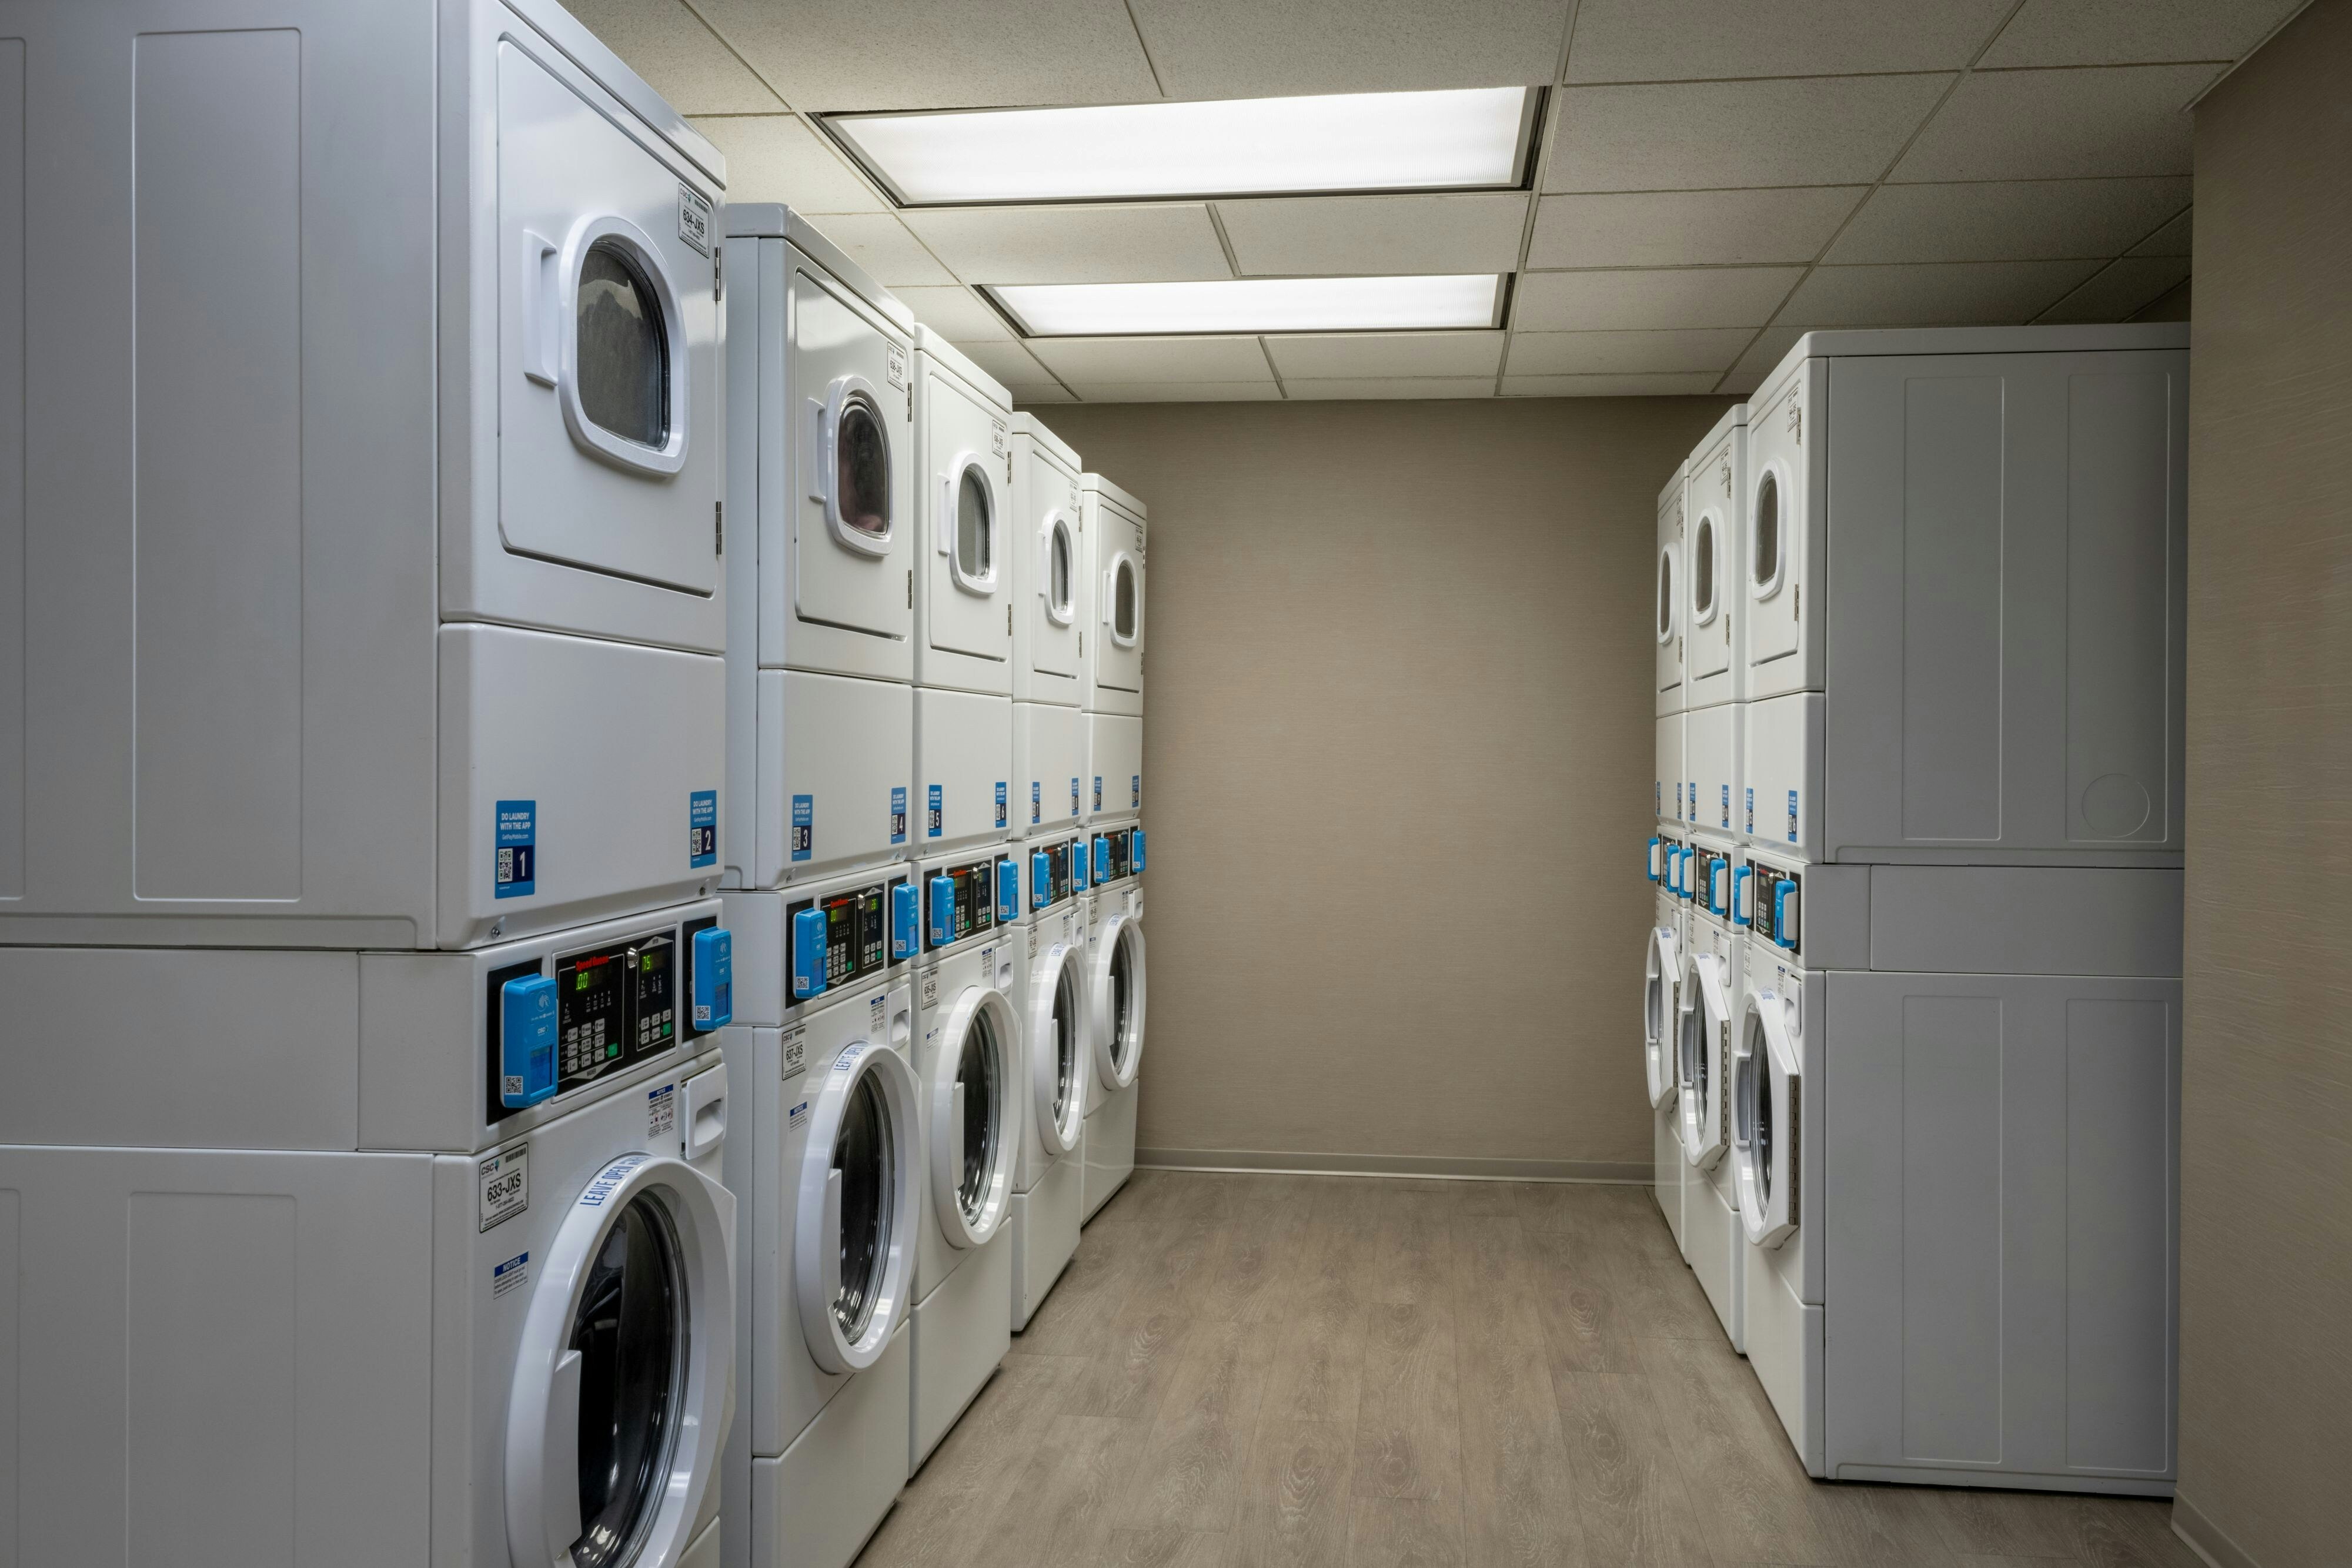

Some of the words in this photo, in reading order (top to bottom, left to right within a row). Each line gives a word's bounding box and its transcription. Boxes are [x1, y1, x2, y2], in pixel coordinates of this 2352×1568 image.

[683, 209, 704, 235] 634-JXS
[936, 812, 940, 827] 5
[1001, 805, 1005, 818] 6
[899, 816, 903, 831] 4
[705, 830, 711, 851] 2
[803, 829, 808, 847] 3
[520, 851, 525, 877] 1
[576, 957, 592, 972] Speed
[786, 1044, 803, 1061] 637-JXS
[481, 1163, 495, 1175] CSC
[487, 1173, 521, 1202] 633-JXS
[579, 1181, 617, 1206] LEAVE
[602, 1165, 634, 1180] OPEN
[503, 1256, 521, 1272] NOTICE
